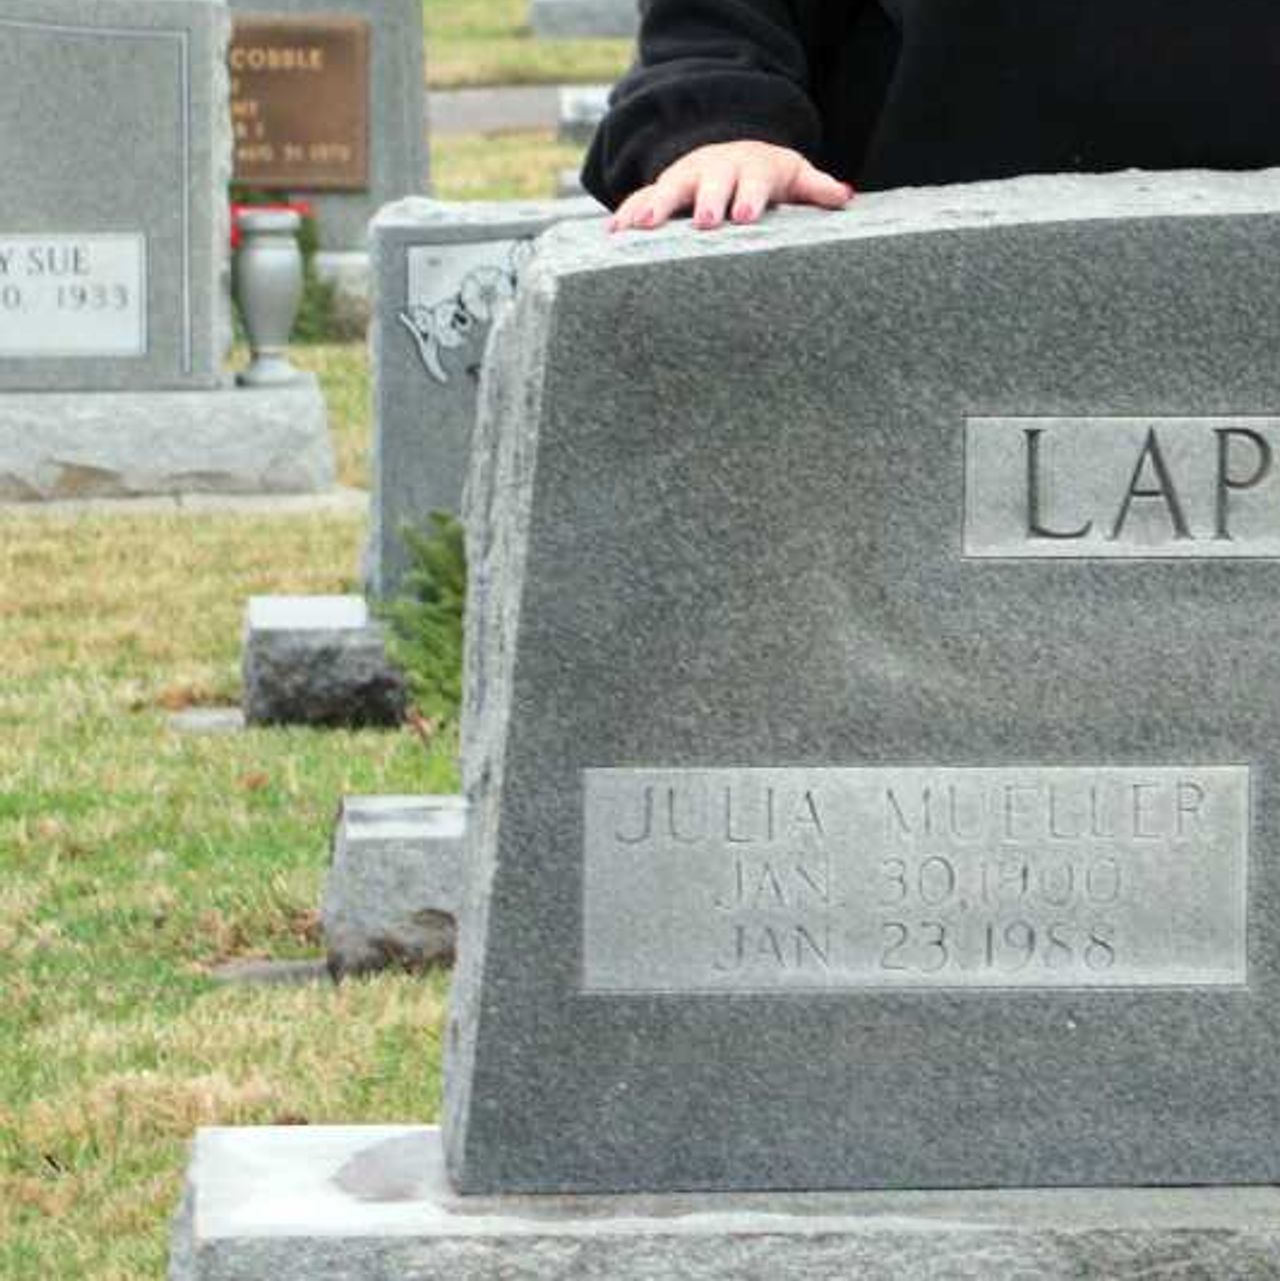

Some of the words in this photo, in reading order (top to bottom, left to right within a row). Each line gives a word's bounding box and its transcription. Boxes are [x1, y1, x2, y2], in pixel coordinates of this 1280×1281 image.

[27, 245, 91, 276] SUE
[614, 785, 826, 844] JULIA
[884, 780, 1208, 842] MUELLER
